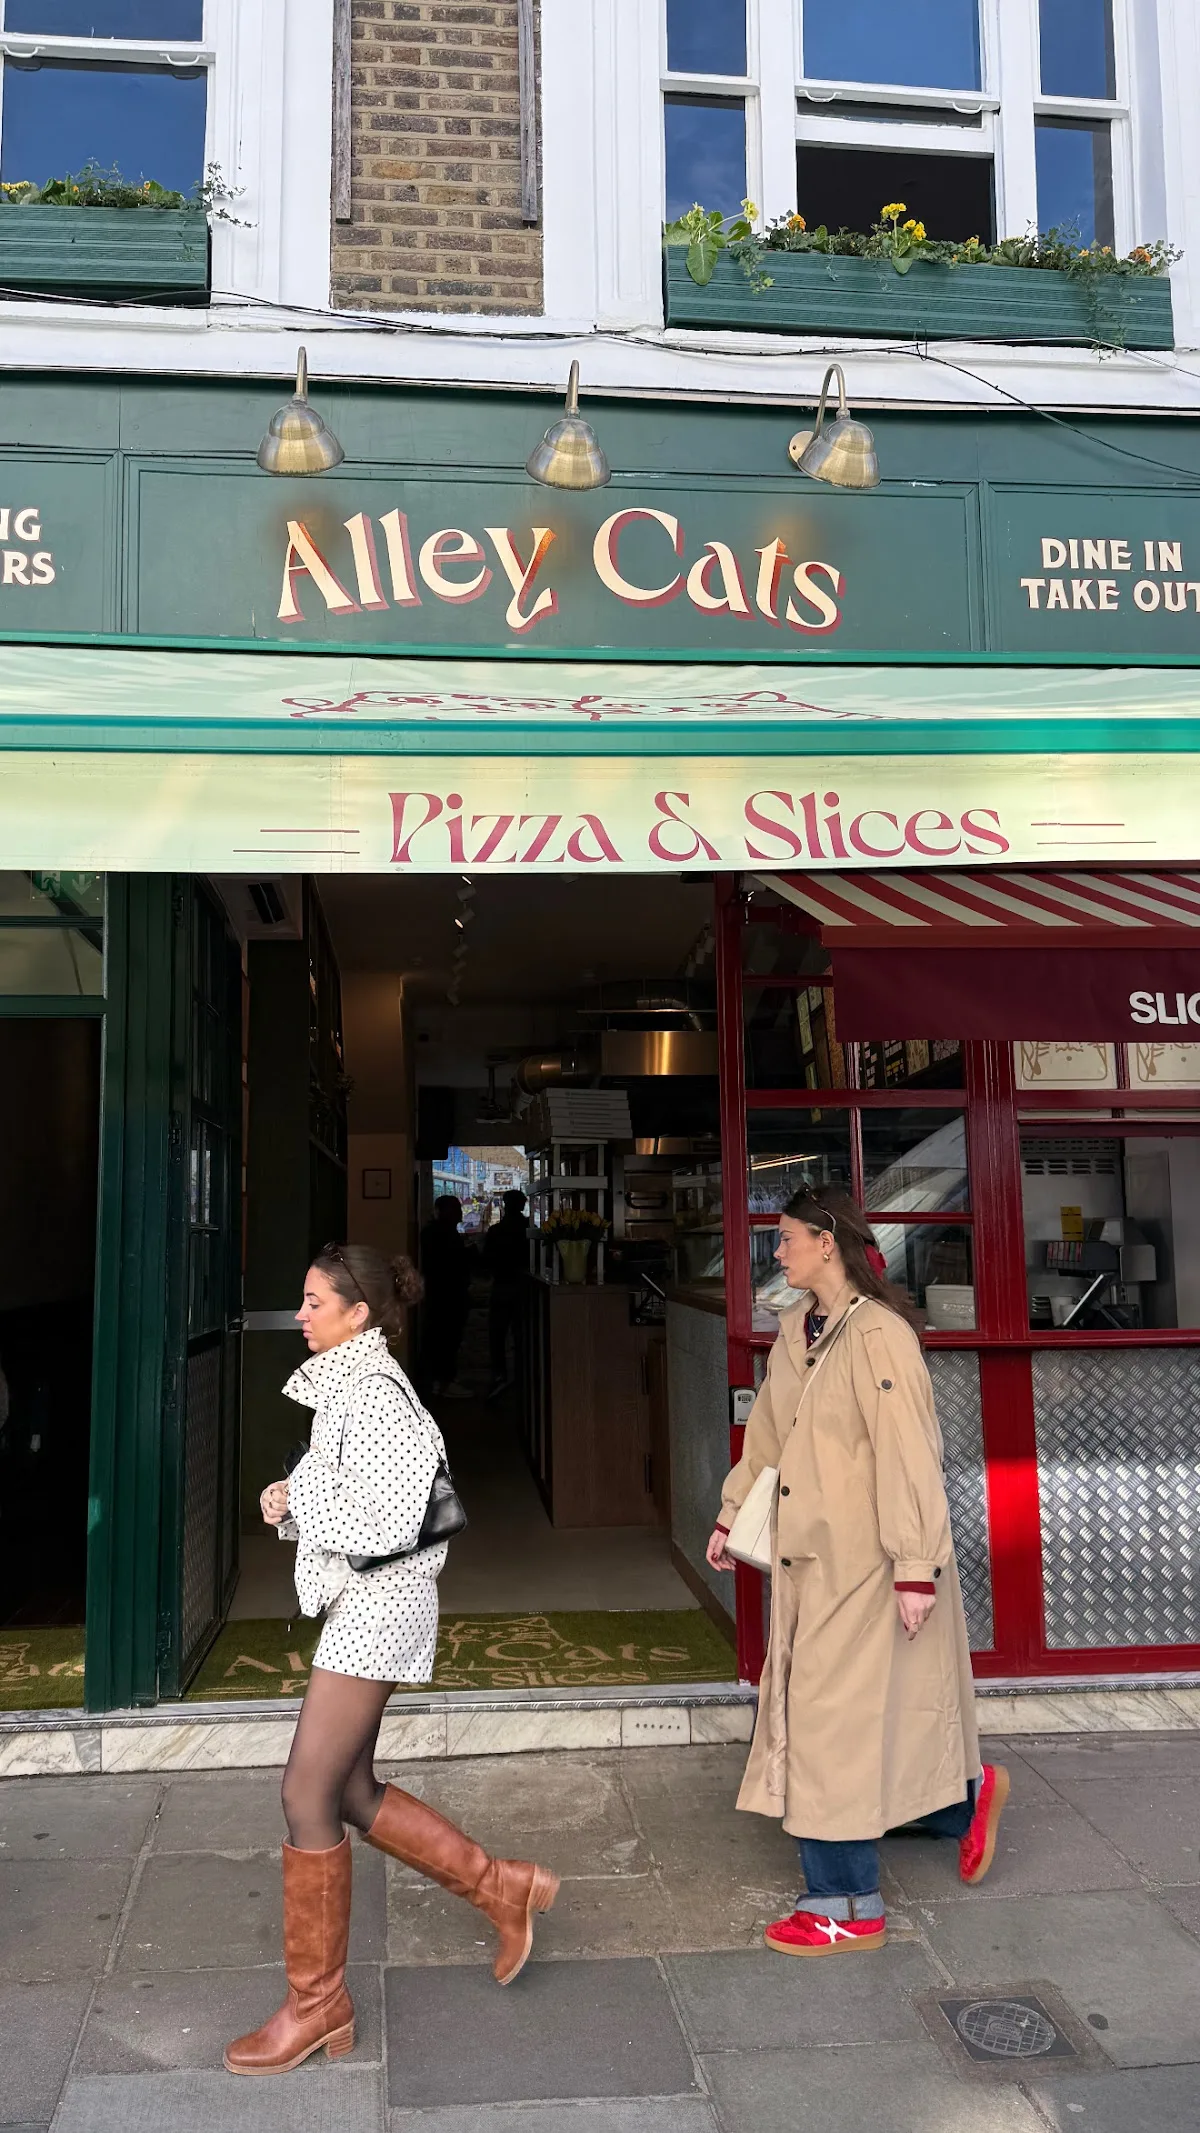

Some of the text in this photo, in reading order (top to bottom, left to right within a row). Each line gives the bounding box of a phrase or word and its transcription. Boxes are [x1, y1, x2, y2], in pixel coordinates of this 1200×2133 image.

[277, 507, 845, 635] Alley Cats
[1041, 537, 1183, 572] DINE IN
[1020, 578, 1121, 610] TAKE
[388, 790, 1010, 864] Pizza & Slices
[484, 1641, 691, 1663] Cats
[491, 1671, 651, 1687] Slices
